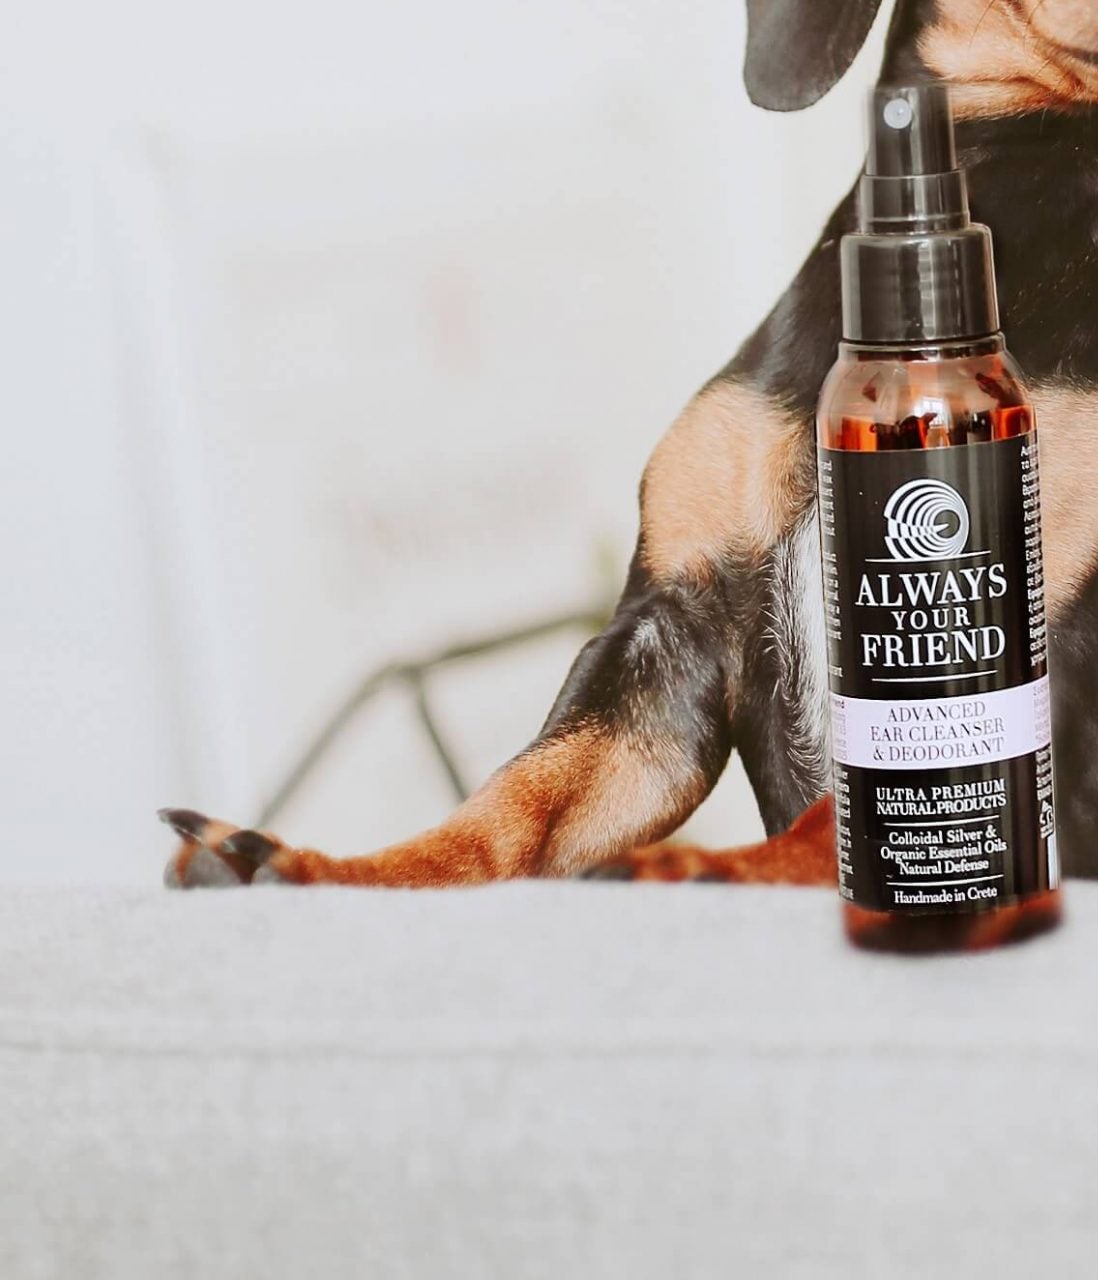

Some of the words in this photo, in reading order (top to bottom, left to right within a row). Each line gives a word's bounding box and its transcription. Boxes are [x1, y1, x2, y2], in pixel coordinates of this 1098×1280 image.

[855, 563, 1007, 607] ALWAYS
[891, 607, 971, 630] YOUR
[860, 625, 1006, 667] FRIEND
[887, 701, 986, 723] ADVANCED
[870, 724, 903, 742] EAR
[909, 718, 1005, 742] CLEANSER
[873, 746, 884, 761] &
[889, 737, 1004, 762] DEODORANT
[876, 786, 926, 801] ULTRA
[932, 778, 1005, 800] PREMIUM
[876, 800, 936, 816] NATURAL
[936, 794, 1007, 813] PRODUCTS
[889, 829, 943, 845] Colloidal
[947, 828, 983, 843] Silver
[985, 824, 997, 838] &
[880, 846, 926, 864] Organic
[929, 842, 982, 859] Essential
[984, 839, 1007, 854] Oils
[900, 860, 942, 876] Natural
[944, 858, 989, 873] Defense
[894, 888, 953, 904] Handmade
[954, 888, 966, 902] in
[967, 885, 998, 899] Crete
